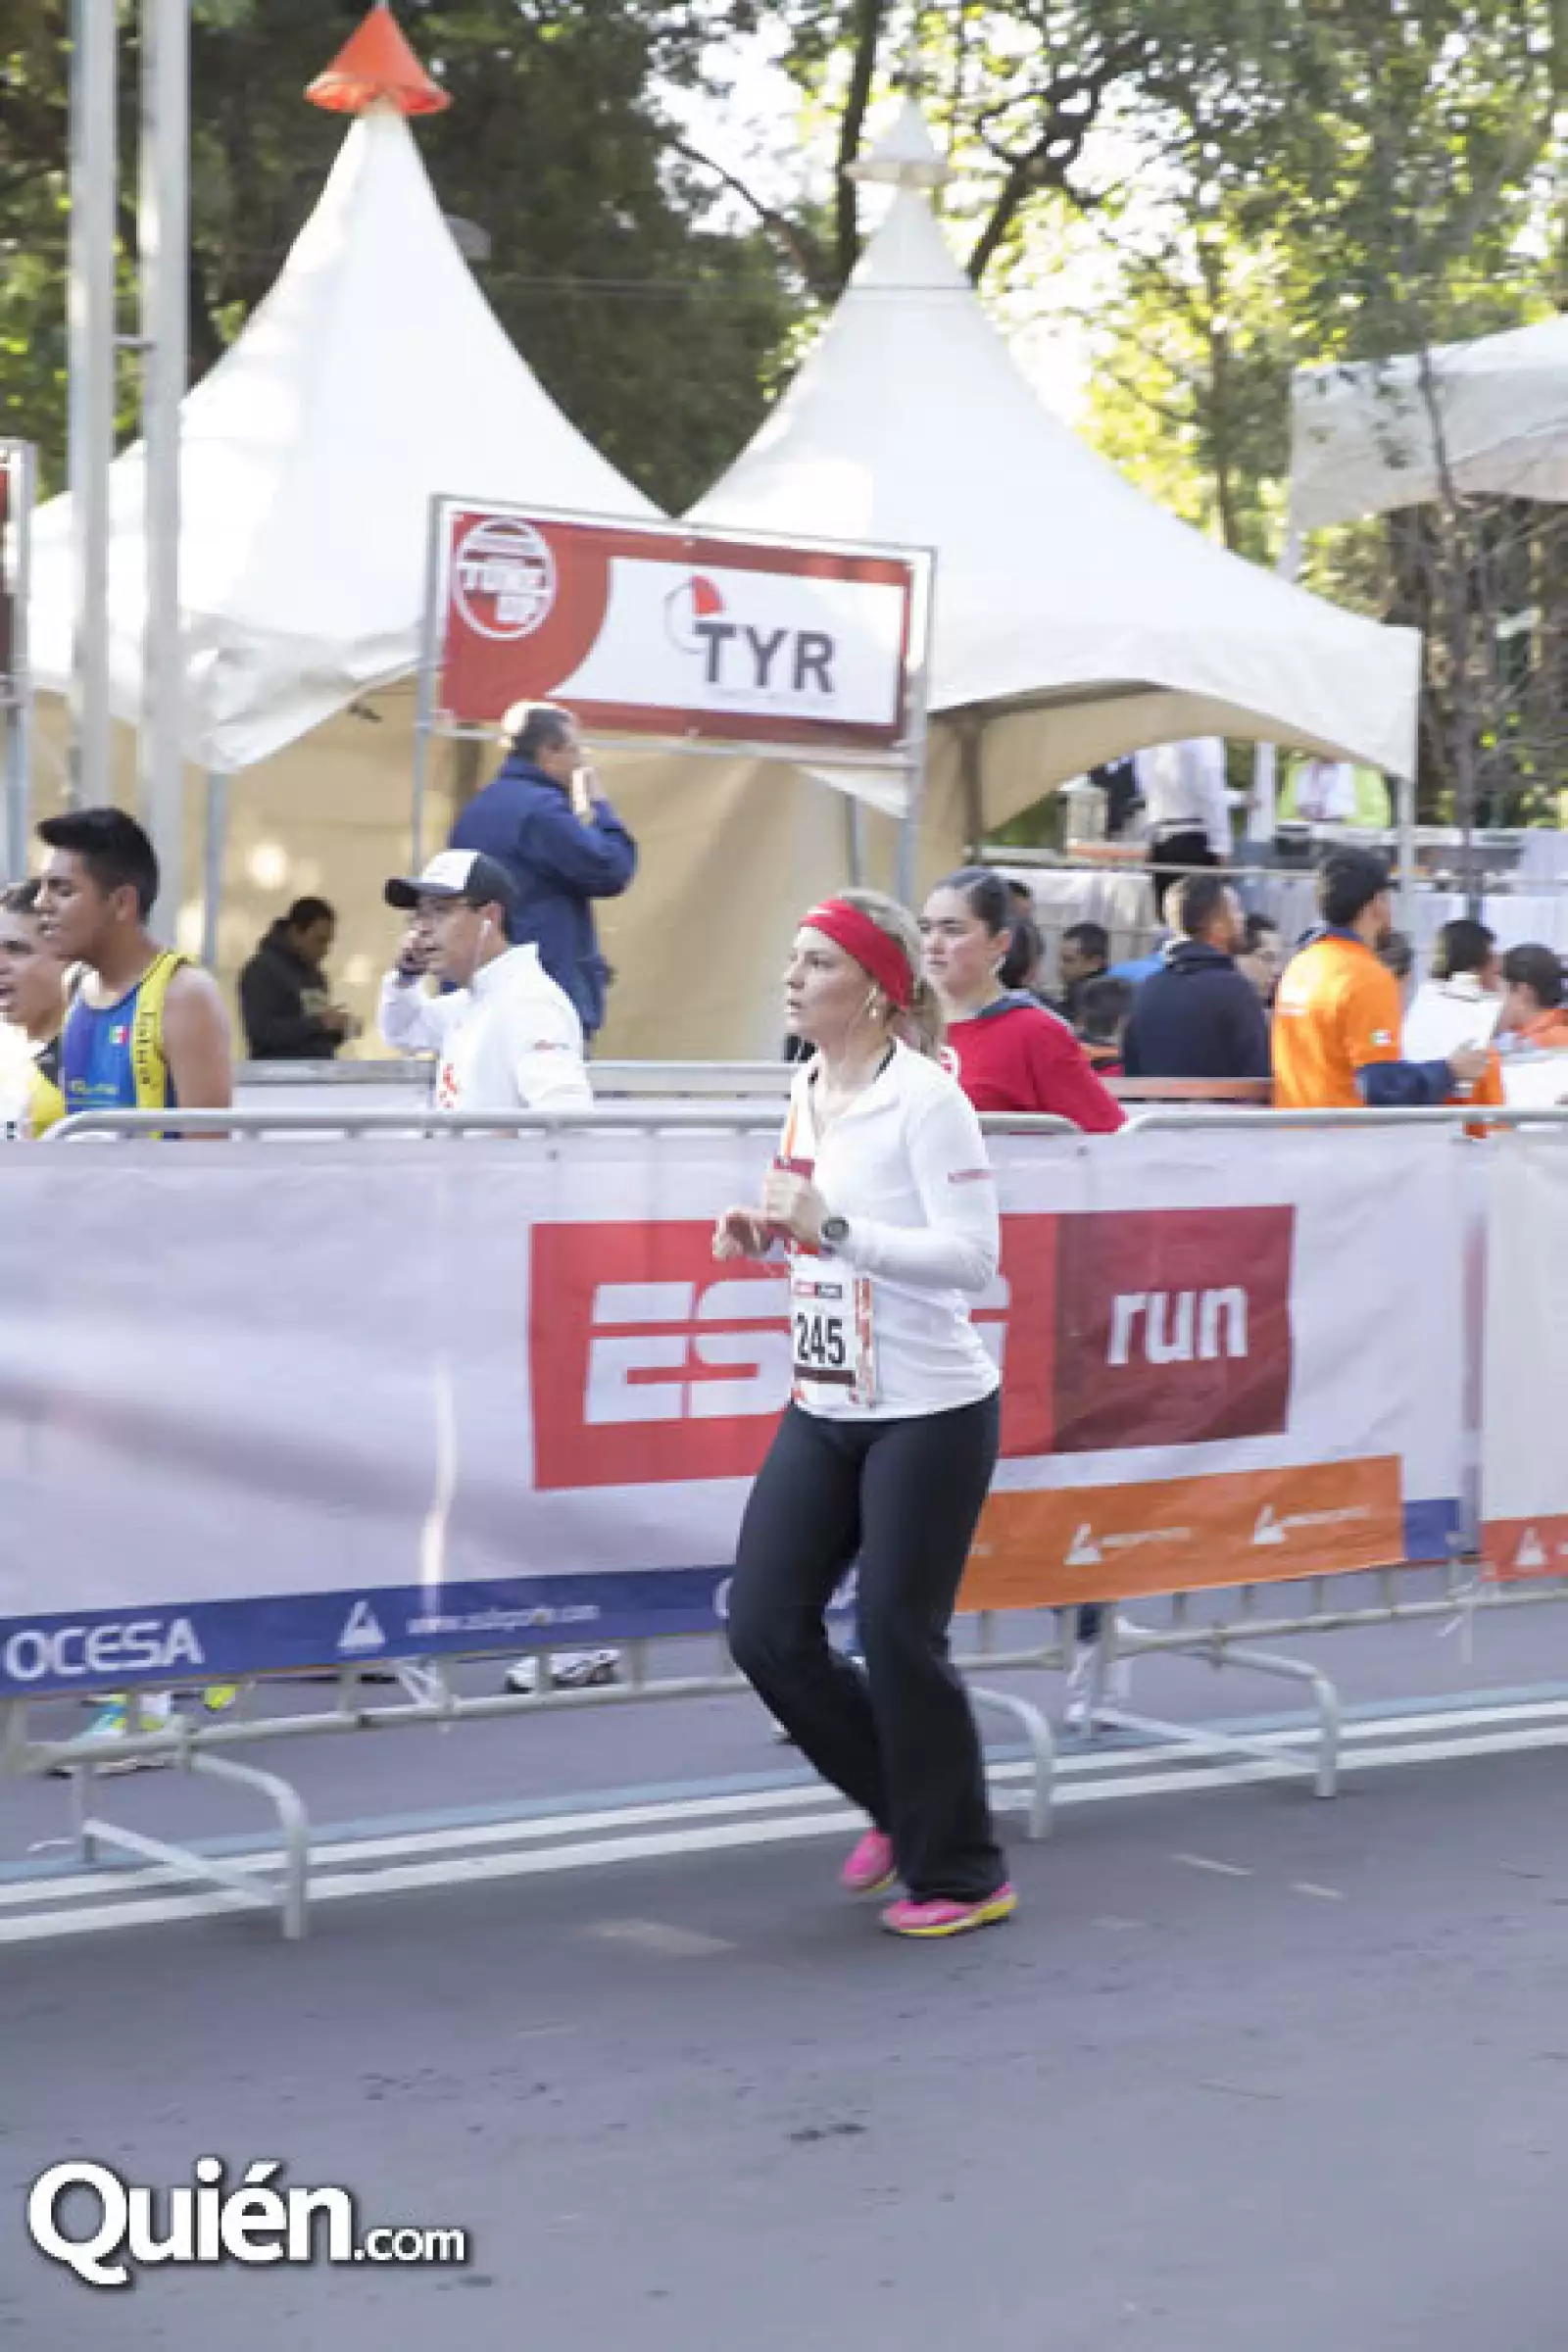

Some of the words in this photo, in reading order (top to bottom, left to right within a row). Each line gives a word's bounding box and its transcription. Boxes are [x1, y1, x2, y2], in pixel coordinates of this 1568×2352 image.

[693, 622, 835, 693] TYR
[794, 1311, 847, 1365] 245
[1105, 1283, 1248, 1365] run
[4, 1617, 205, 1681] OCESA
